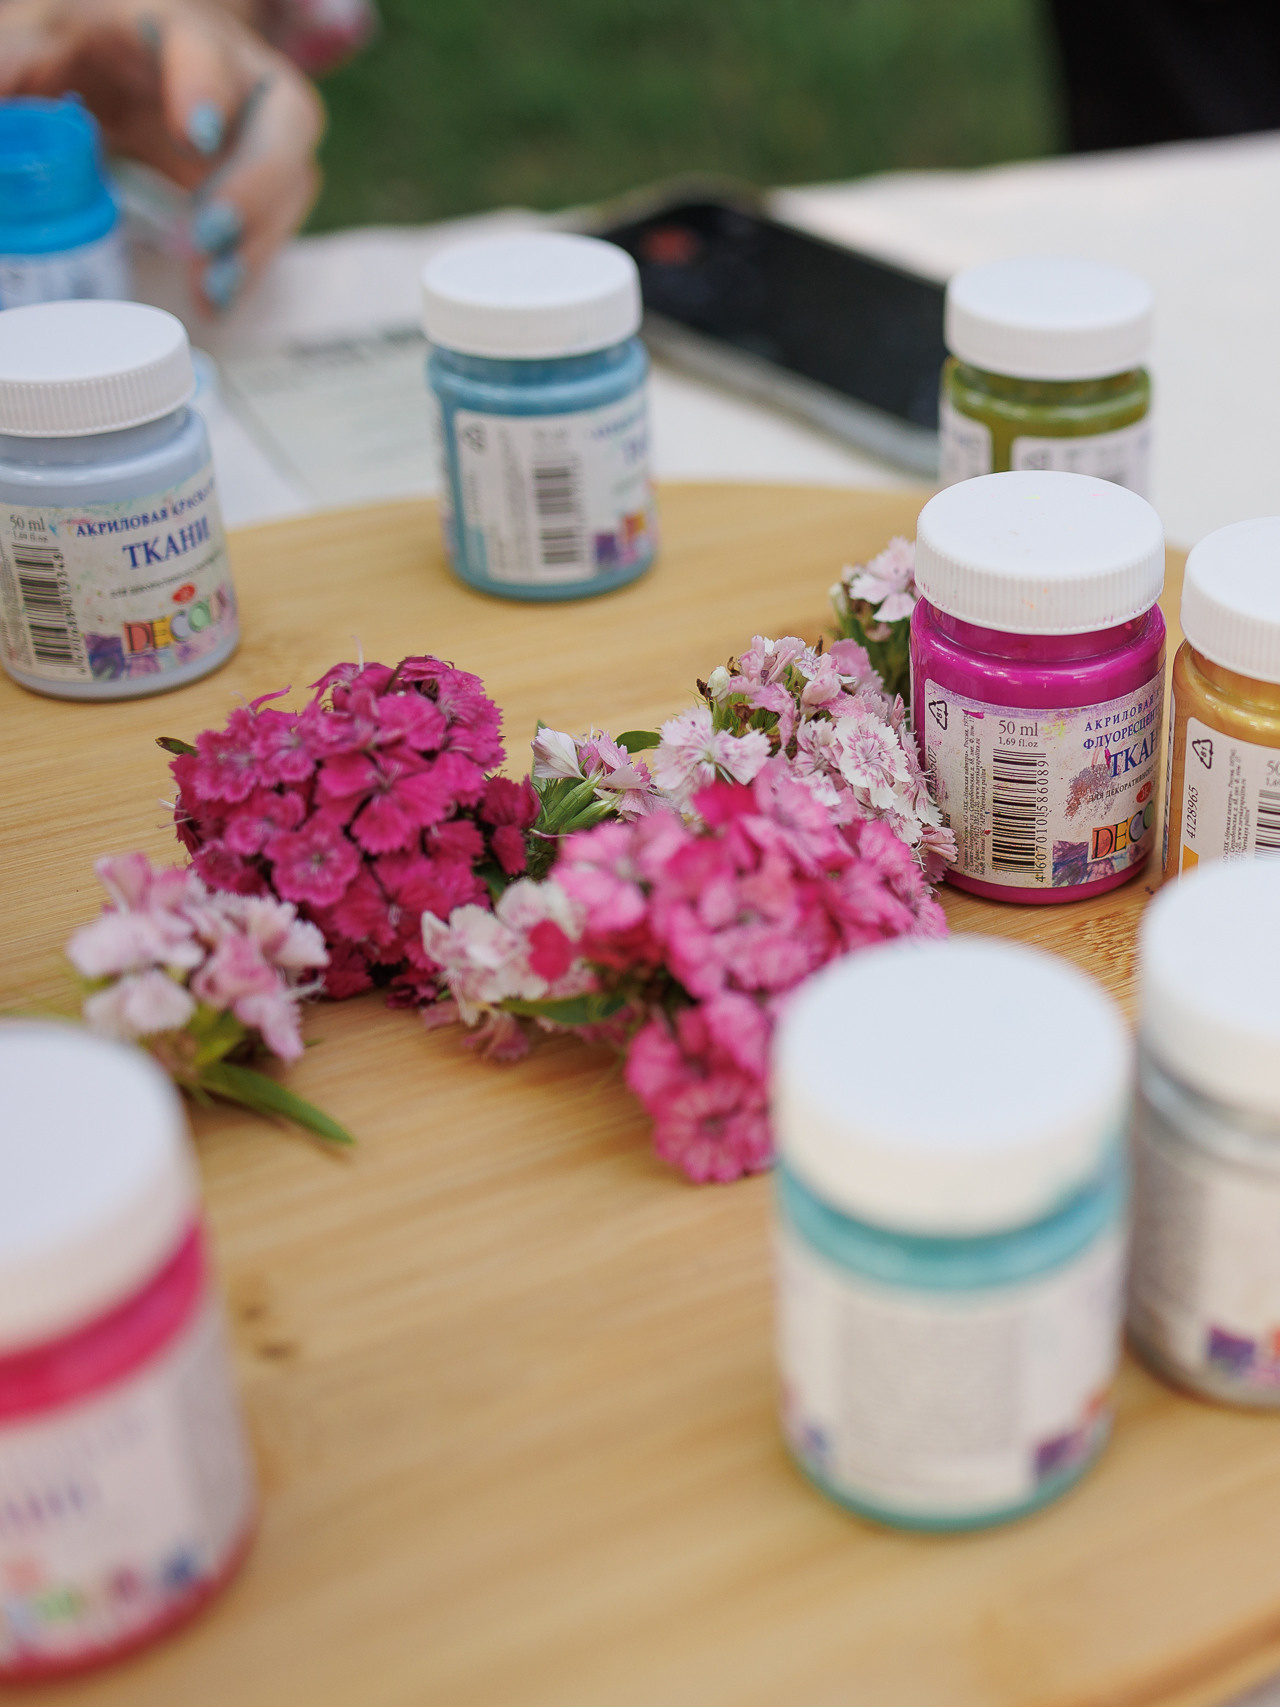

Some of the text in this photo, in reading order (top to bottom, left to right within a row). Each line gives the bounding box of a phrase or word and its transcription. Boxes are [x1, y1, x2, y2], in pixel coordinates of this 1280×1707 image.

[28, 516, 45, 532] ml
[76, 507, 168, 537] АКРИЛОВАЯ
[122, 516, 210, 569] ТКАНИ
[998, 720, 1038, 737] 50 ml
[1084, 694, 1154, 731] АКРИЛОВАЯ
[1186, 784, 1199, 839] 4128965
